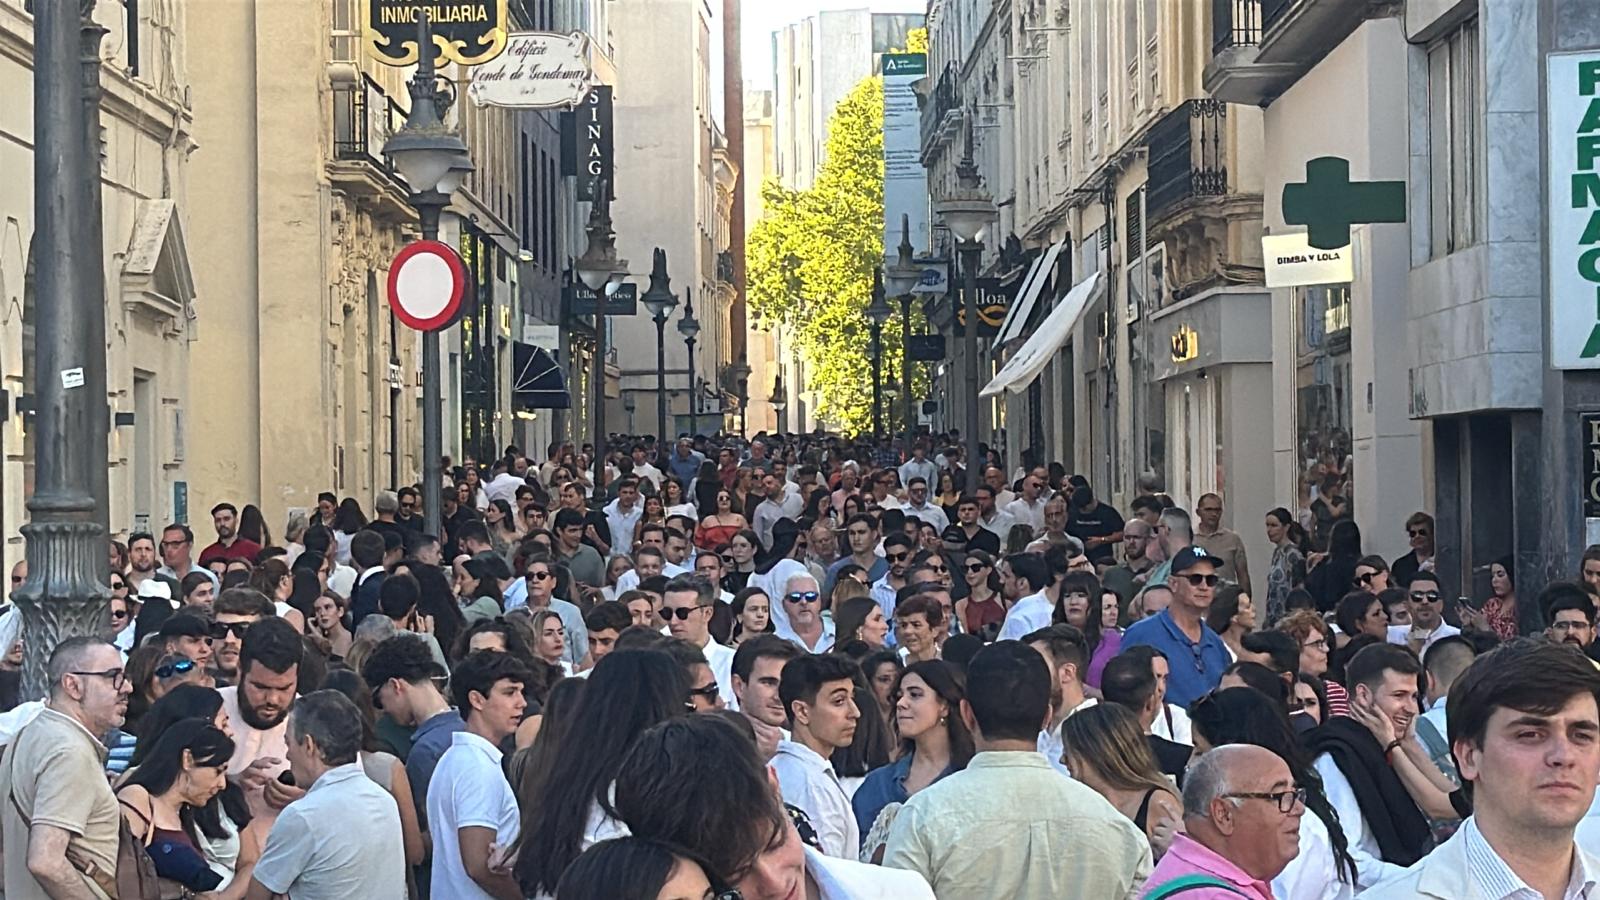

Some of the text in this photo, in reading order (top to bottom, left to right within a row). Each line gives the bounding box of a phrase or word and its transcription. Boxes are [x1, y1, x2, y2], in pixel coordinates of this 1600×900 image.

[381, 5, 488, 23] INMOBILIARIA
[509, 64, 524, 80] de
[1317, 252, 1340, 261] LOLA
